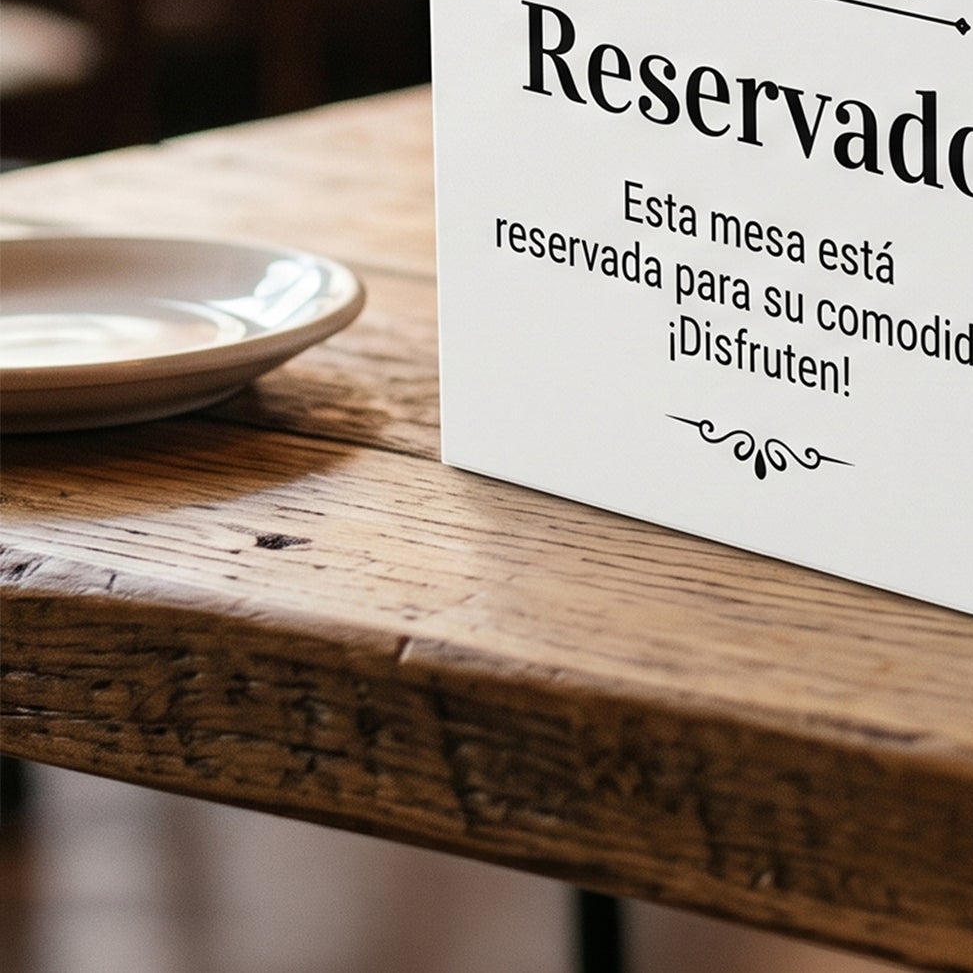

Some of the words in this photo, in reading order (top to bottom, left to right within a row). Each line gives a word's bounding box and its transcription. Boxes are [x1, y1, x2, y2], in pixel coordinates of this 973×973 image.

[496, 217, 662, 289] reservada
[676, 263, 751, 312] para
[763, 286, 804, 324] su
[624, 180, 697, 237] Esta
[711, 211, 805, 264] mesa
[818, 238, 895, 285] está
[669, 314, 850, 397] ¡Disfruten!
